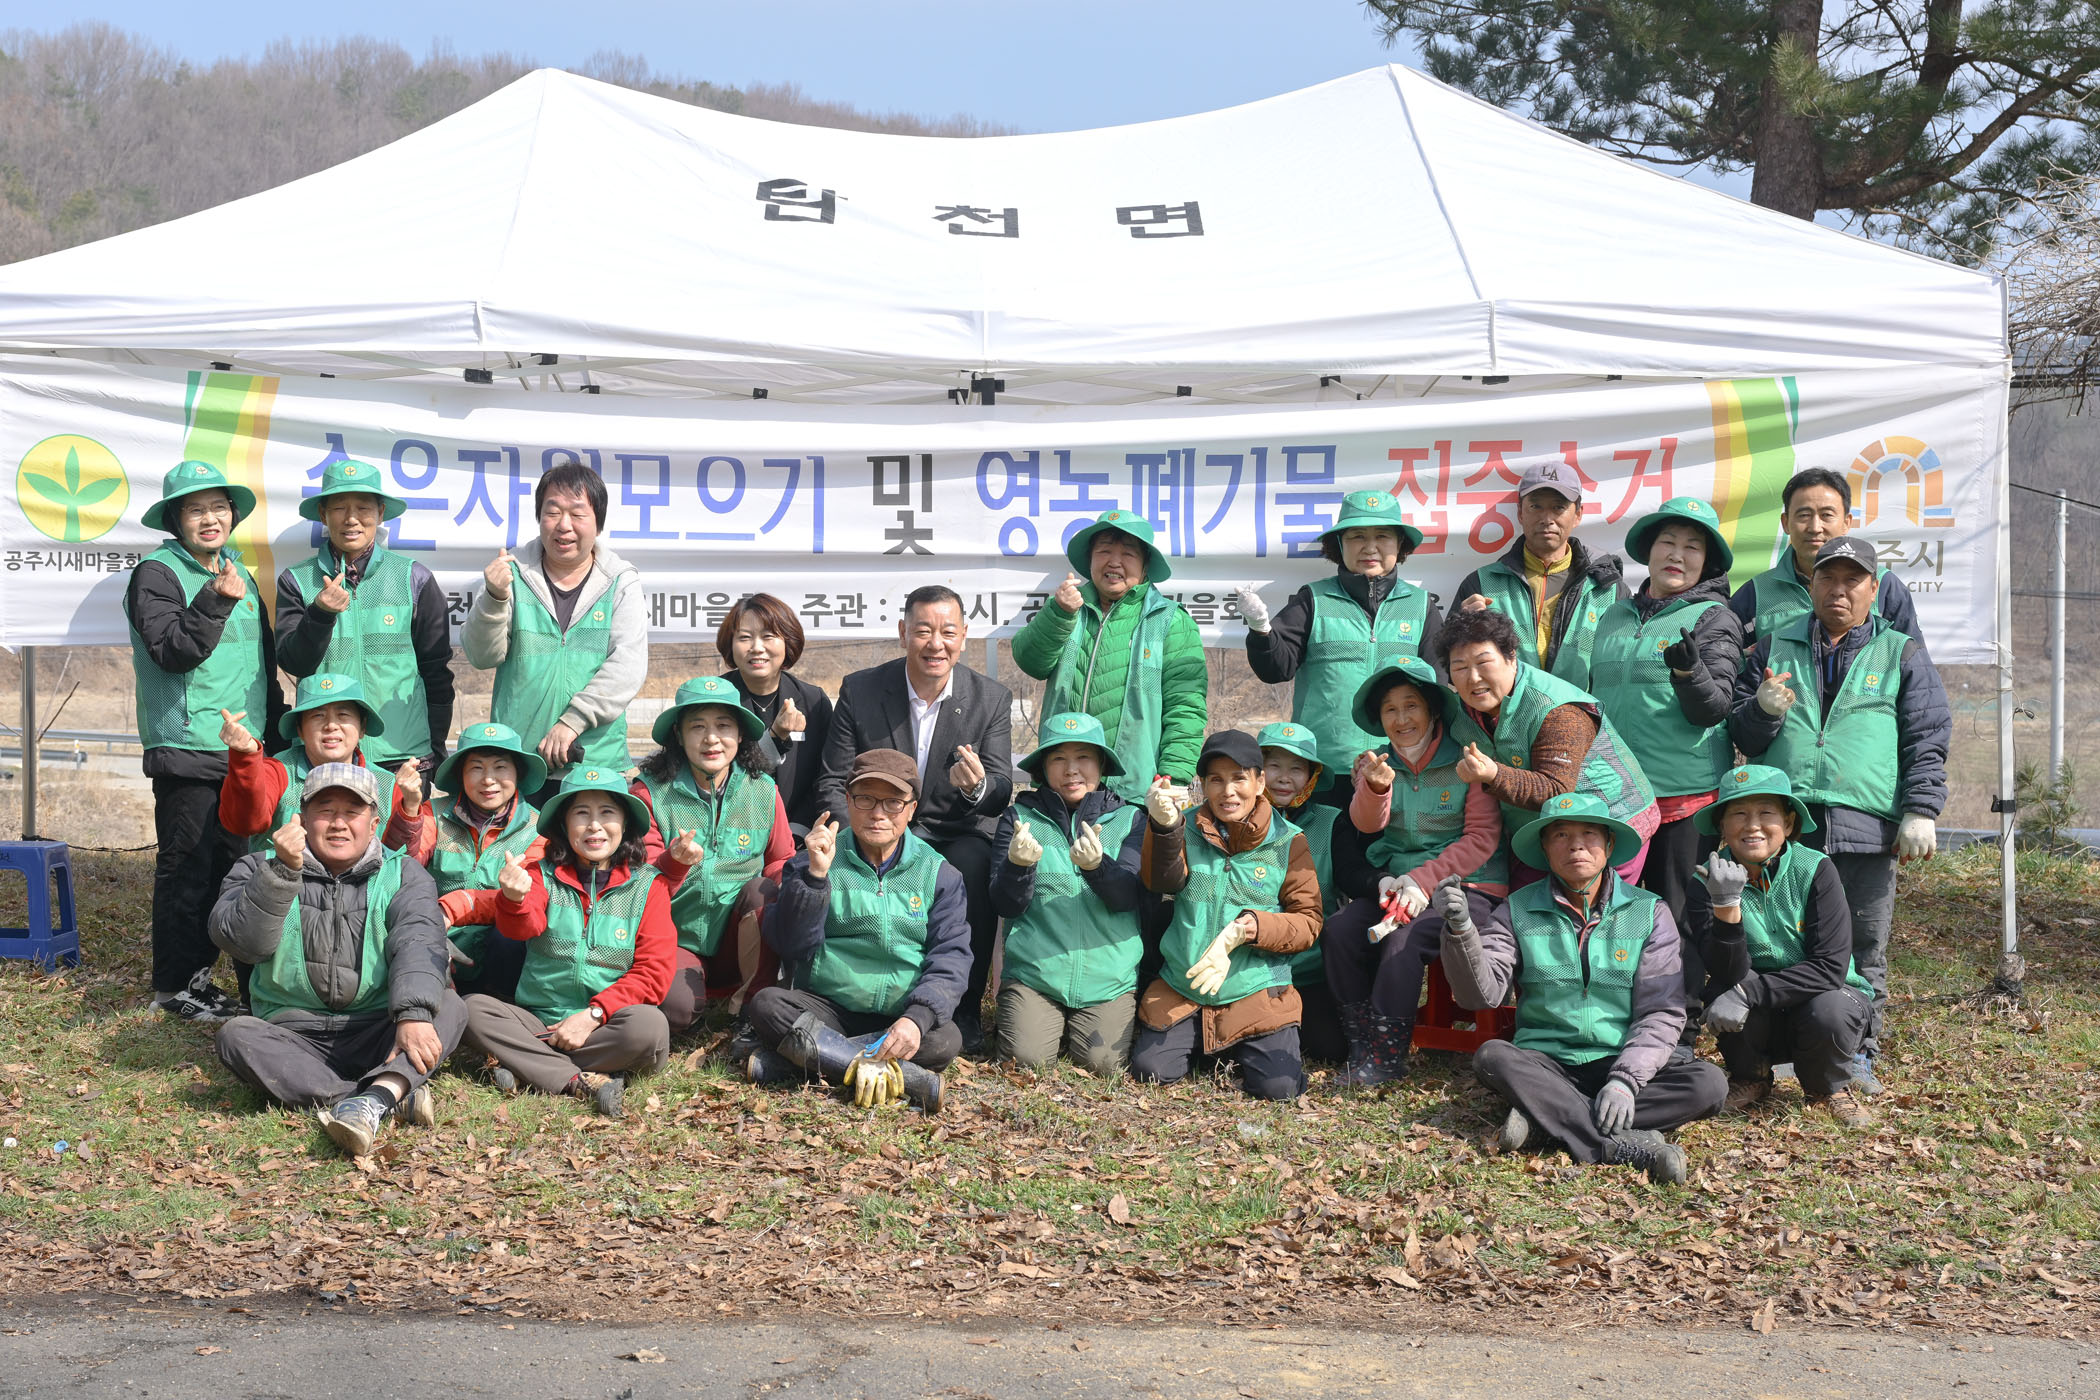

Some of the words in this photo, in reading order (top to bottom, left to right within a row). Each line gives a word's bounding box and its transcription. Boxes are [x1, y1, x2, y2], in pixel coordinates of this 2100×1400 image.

[932, 205, 1019, 239] 천
[1116, 201, 1204, 239] 면
[1541, 466, 1559, 481] LA
[867, 453, 935, 555] 및
[976, 445, 1345, 558] 영농폐기물
[4, 551, 141, 573] 공주시새마을회
[1876, 541, 1944, 576] 주시
[1908, 581, 1944, 593] CITY
[800, 593, 867, 627] 주관
